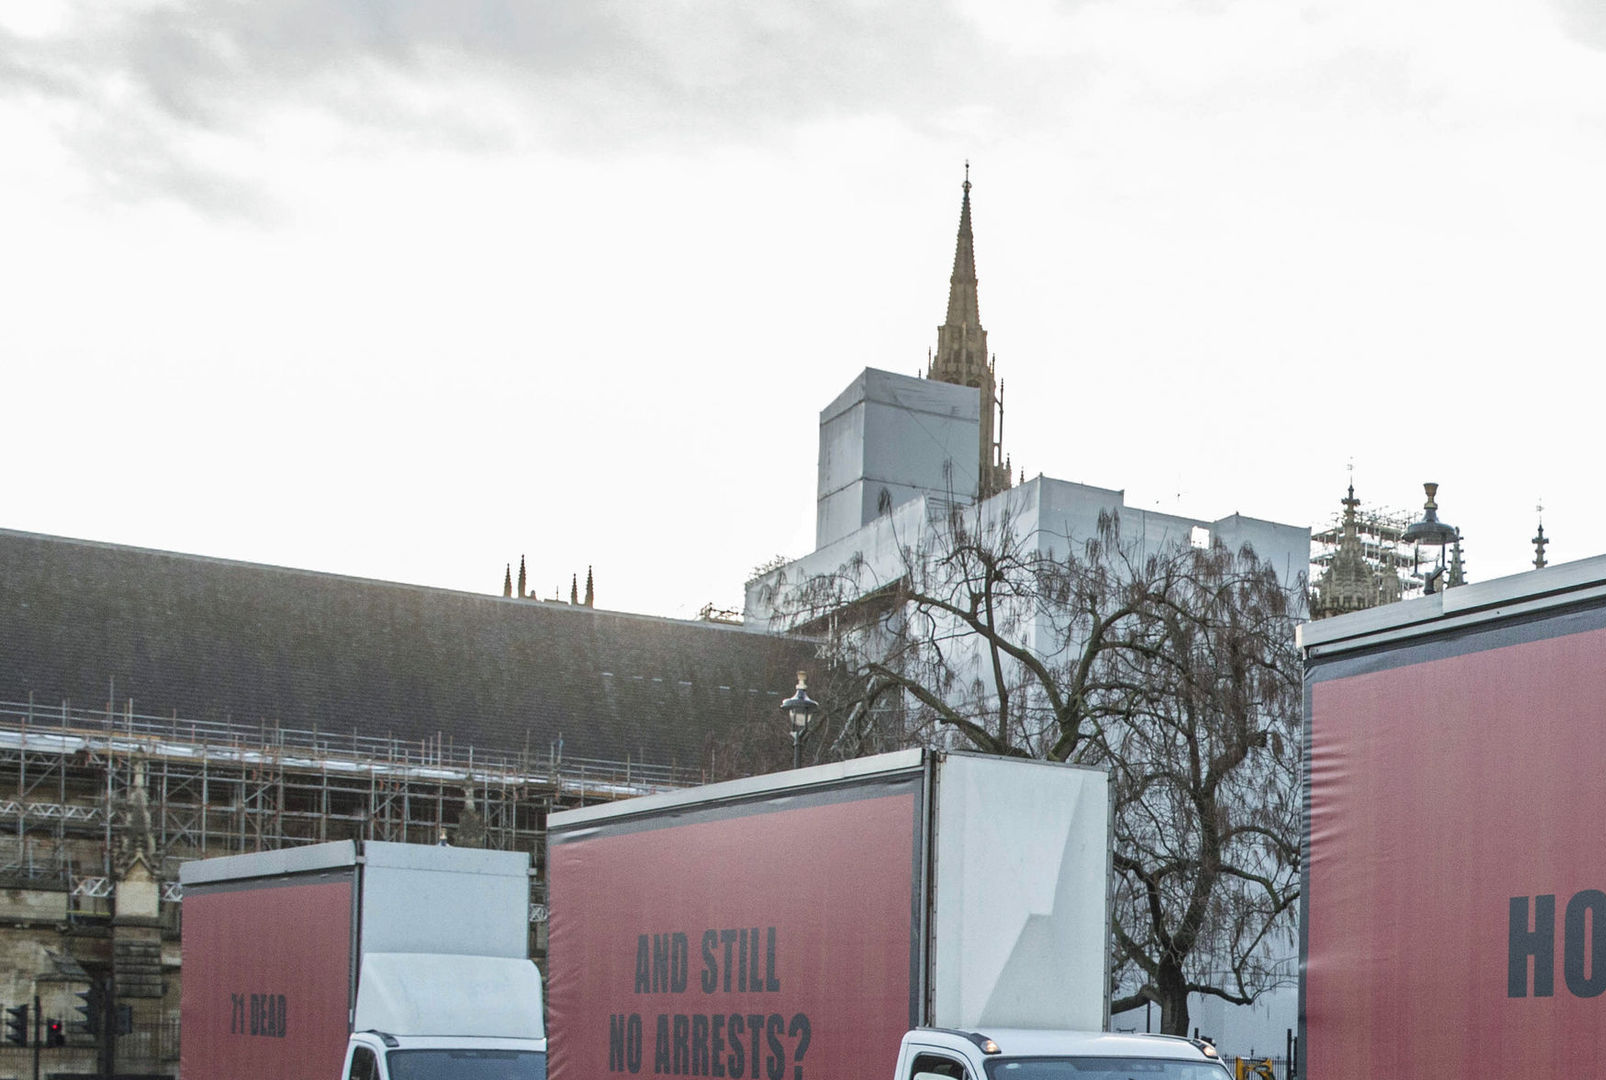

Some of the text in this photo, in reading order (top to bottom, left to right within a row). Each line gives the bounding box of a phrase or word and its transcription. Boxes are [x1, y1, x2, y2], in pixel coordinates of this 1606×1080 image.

[634, 926, 781, 994] AND STILL
[231, 992, 286, 1038] 71 DEAD
[609, 1012, 643, 1074] NO
